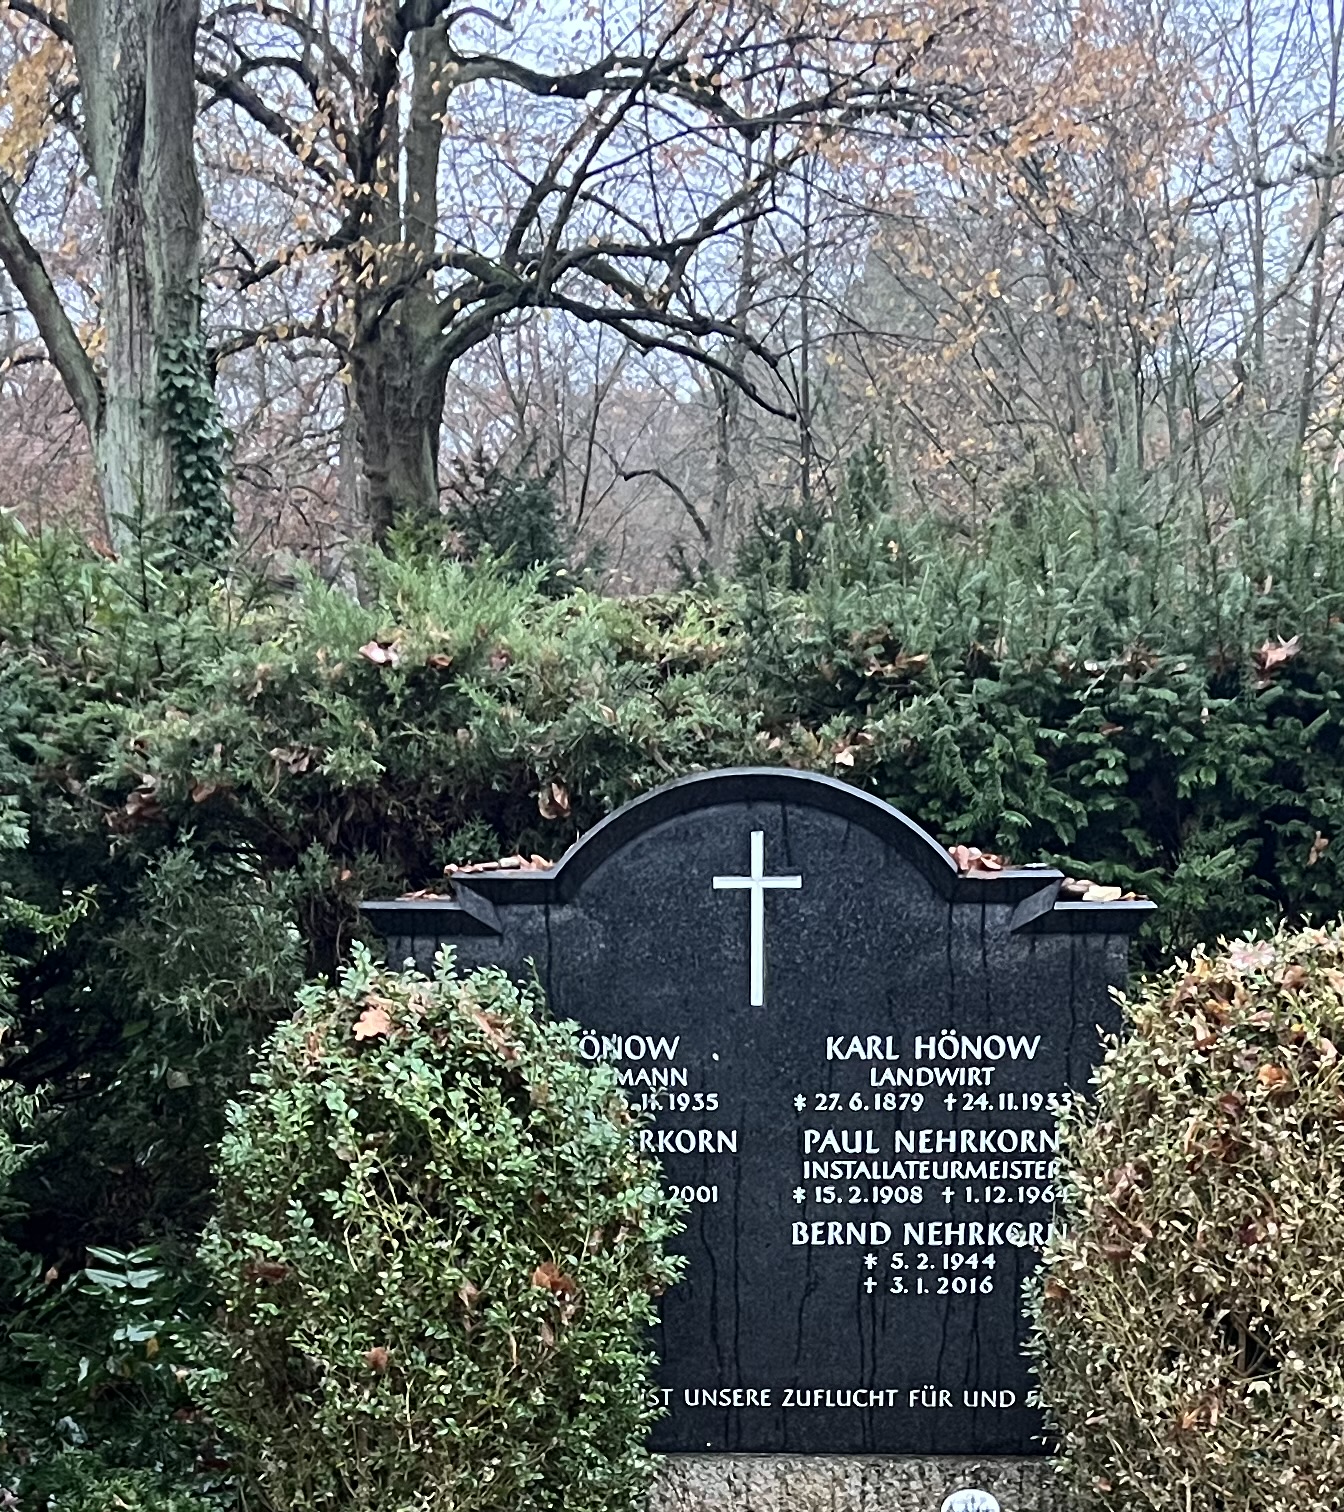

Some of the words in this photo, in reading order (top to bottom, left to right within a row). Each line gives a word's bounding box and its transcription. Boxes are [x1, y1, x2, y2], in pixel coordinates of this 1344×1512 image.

[578, 1029, 680, 1061] ÖNOW
[826, 1036, 900, 1060] KARL
[914, 1029, 1041, 1061] HÖNOW
[614, 1067, 688, 1087] MANN
[869, 1066, 996, 1087] LANDWIRT
[639, 1129, 738, 1154] RKORN
[803, 1129, 880, 1155] PAUL
[894, 1129, 1061, 1154] NEHRKORN
[803, 1160, 1058, 1180] INSTALLATEURMEISTER
[791, 1221, 892, 1247] BERND
[903, 1221, 1069, 1247] NEHRKORN
[684, 1388, 772, 1407] UNSERE
[781, 1388, 899, 1408] ZUFLUCHT
[908, 1384, 954, 1408] FÜR
[963, 1389, 1016, 1408] UND
